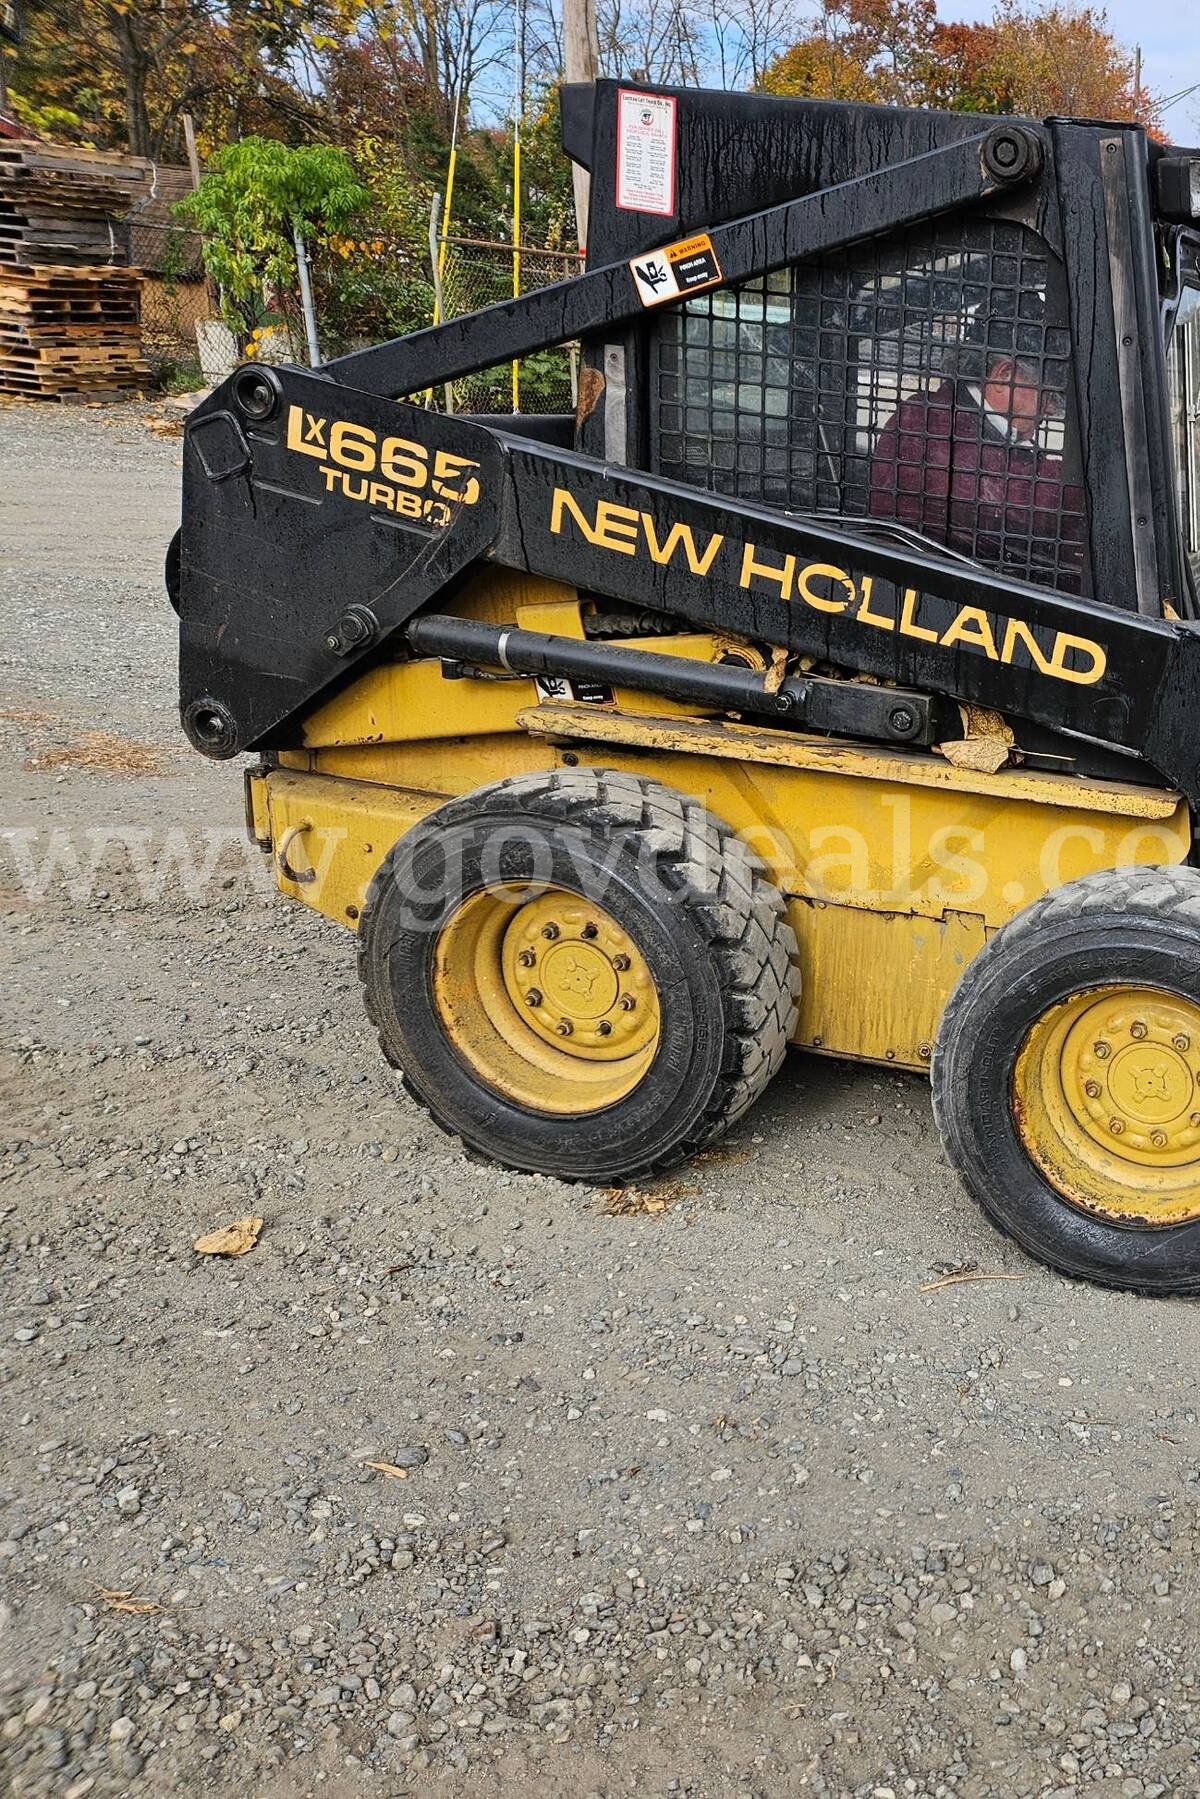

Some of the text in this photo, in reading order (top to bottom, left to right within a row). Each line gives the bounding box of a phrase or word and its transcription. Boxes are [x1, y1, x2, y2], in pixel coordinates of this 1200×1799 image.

[679, 240, 706, 254] WARNING
[319, 465, 451, 526] TURBO
[550, 487, 1108, 685] NEW HOLLAND
